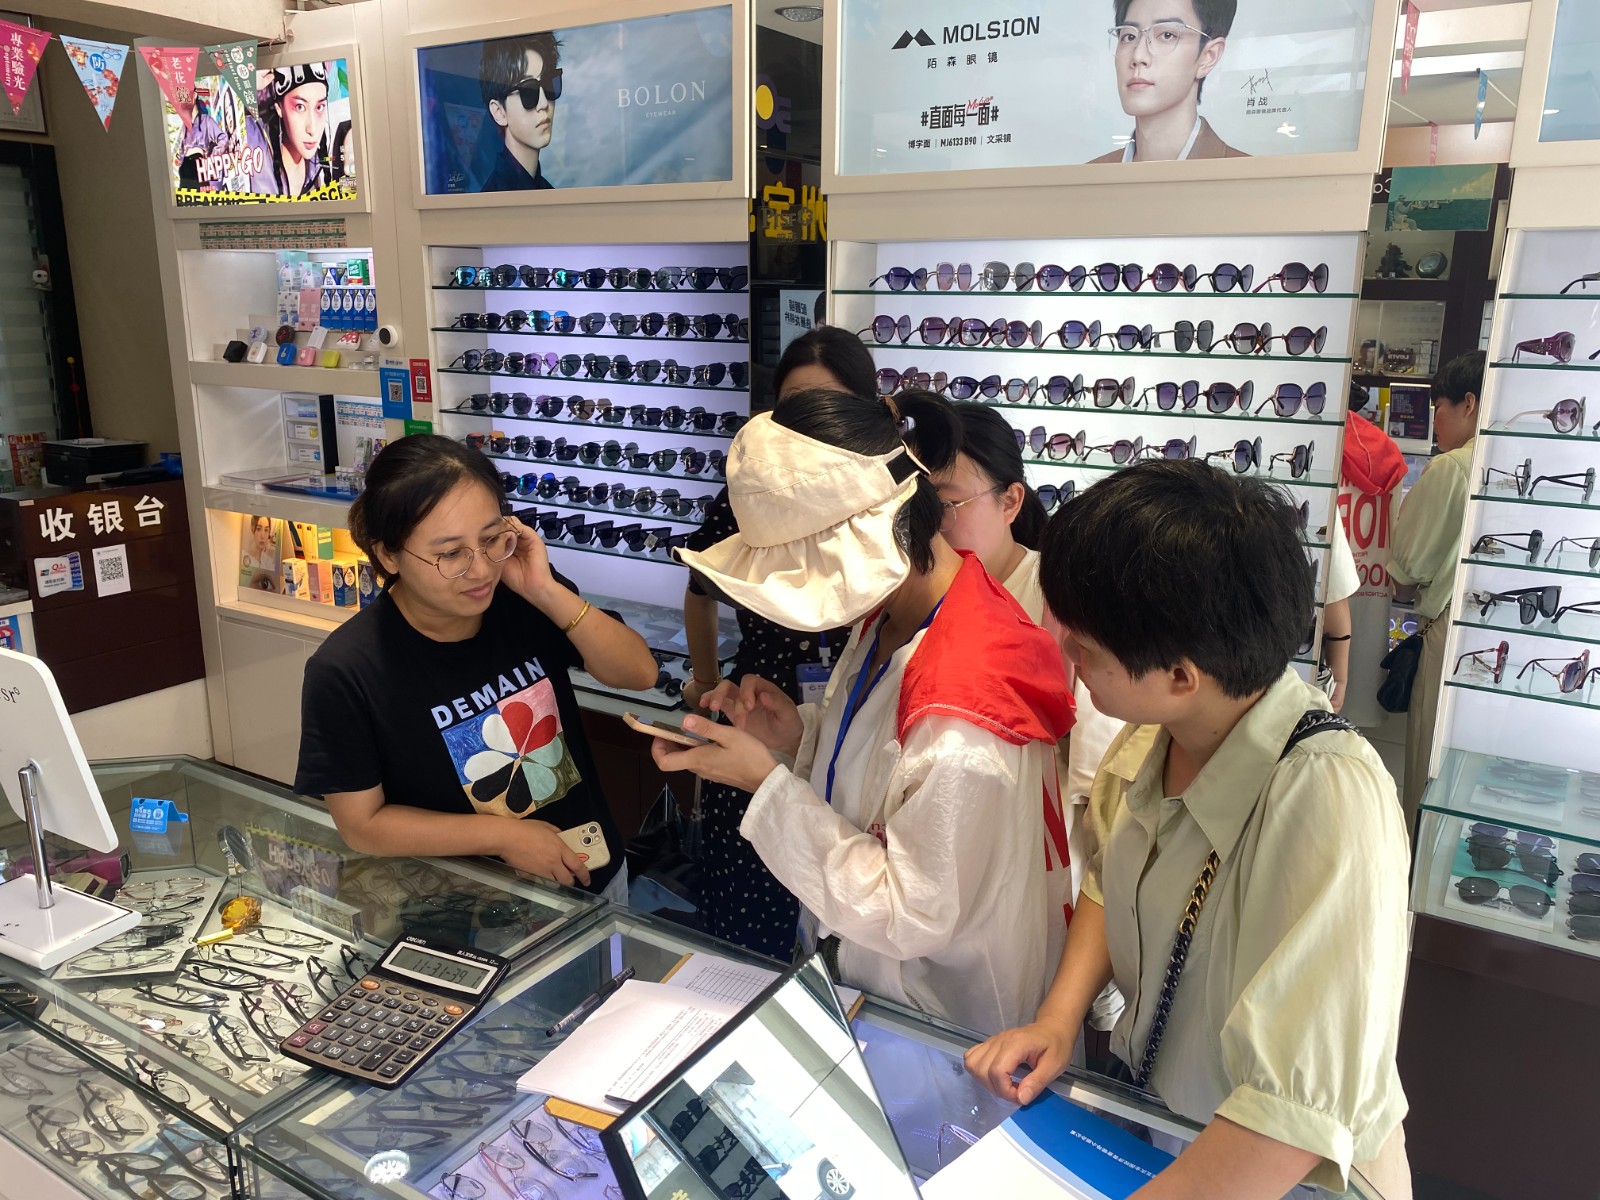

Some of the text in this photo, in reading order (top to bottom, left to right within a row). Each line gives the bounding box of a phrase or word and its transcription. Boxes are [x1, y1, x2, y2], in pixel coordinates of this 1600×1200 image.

[943, 16, 1040, 44] MOLSION
[927, 51, 998, 69] 陌森眼镜
[617, 80, 706, 107] BOLON
[1247, 97, 1268, 107] 肖战
[645, 110, 677, 118] EYEWEAR
[921, 102, 1009, 129] #直面每一面#
[908, 139, 931, 149] 博学面
[196, 147, 263, 183] HAPPY GO
[39, 495, 165, 542] 收银台
[431, 657, 546, 730] DEMAIN
